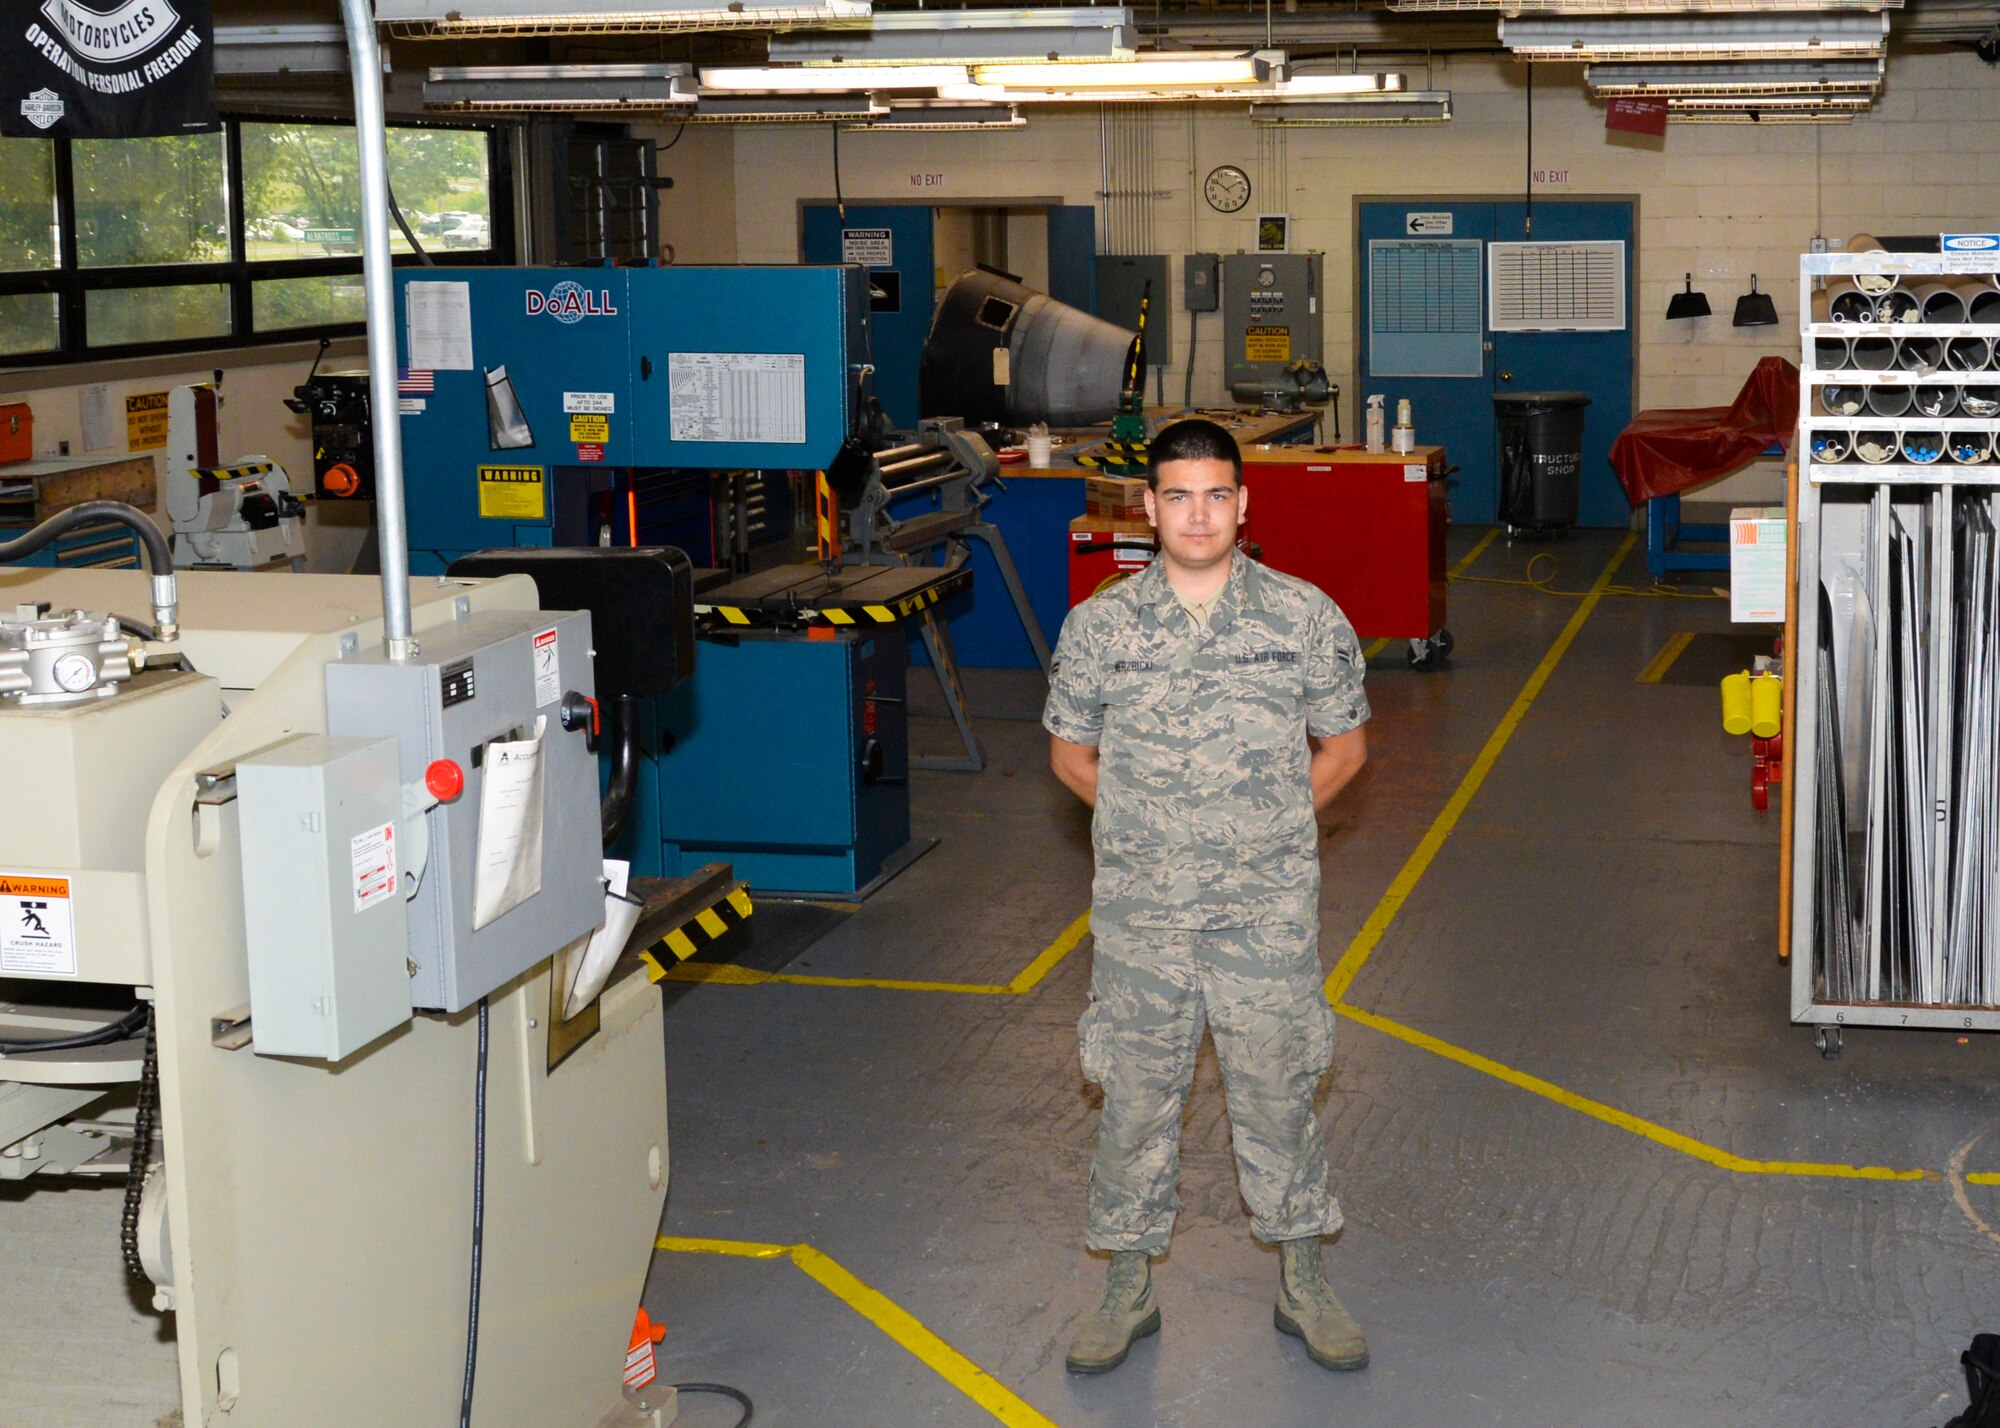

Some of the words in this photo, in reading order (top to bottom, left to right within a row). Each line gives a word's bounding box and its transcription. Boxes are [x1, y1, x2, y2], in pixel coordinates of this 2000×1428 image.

[60, 4, 156, 49] MOTORCYCLES
[25, 23, 88, 87] OPERATION
[87, 69, 145, 94] PERSONAL
[910, 174, 922, 187] NO
[925, 174, 944, 187] EXIT
[1532, 170, 1546, 184] NO
[1549, 170, 1569, 183] EXIT
[306, 231, 340, 241] ALBATROSS
[847, 231, 886, 239] WARNING
[1957, 239, 1987, 247] NOTICE
[525, 289, 618, 315] DoALL
[1247, 327, 1288, 335] CAUTION
[129, 394, 168, 412] CAUTION
[572, 414, 607, 423] CAUTION
[484, 470, 538, 481] WARNING
[1547, 464, 1575, 476] SHOP
[1254, 651, 1270, 663] AIR
[1271, 651, 1297, 662] FORCE
[12, 884, 67, 895] WARNING
[1836, 1011, 1845, 1023] 6
[1901, 1014, 1909, 1025] 7
[1963, 1017, 1973, 1028] 8
